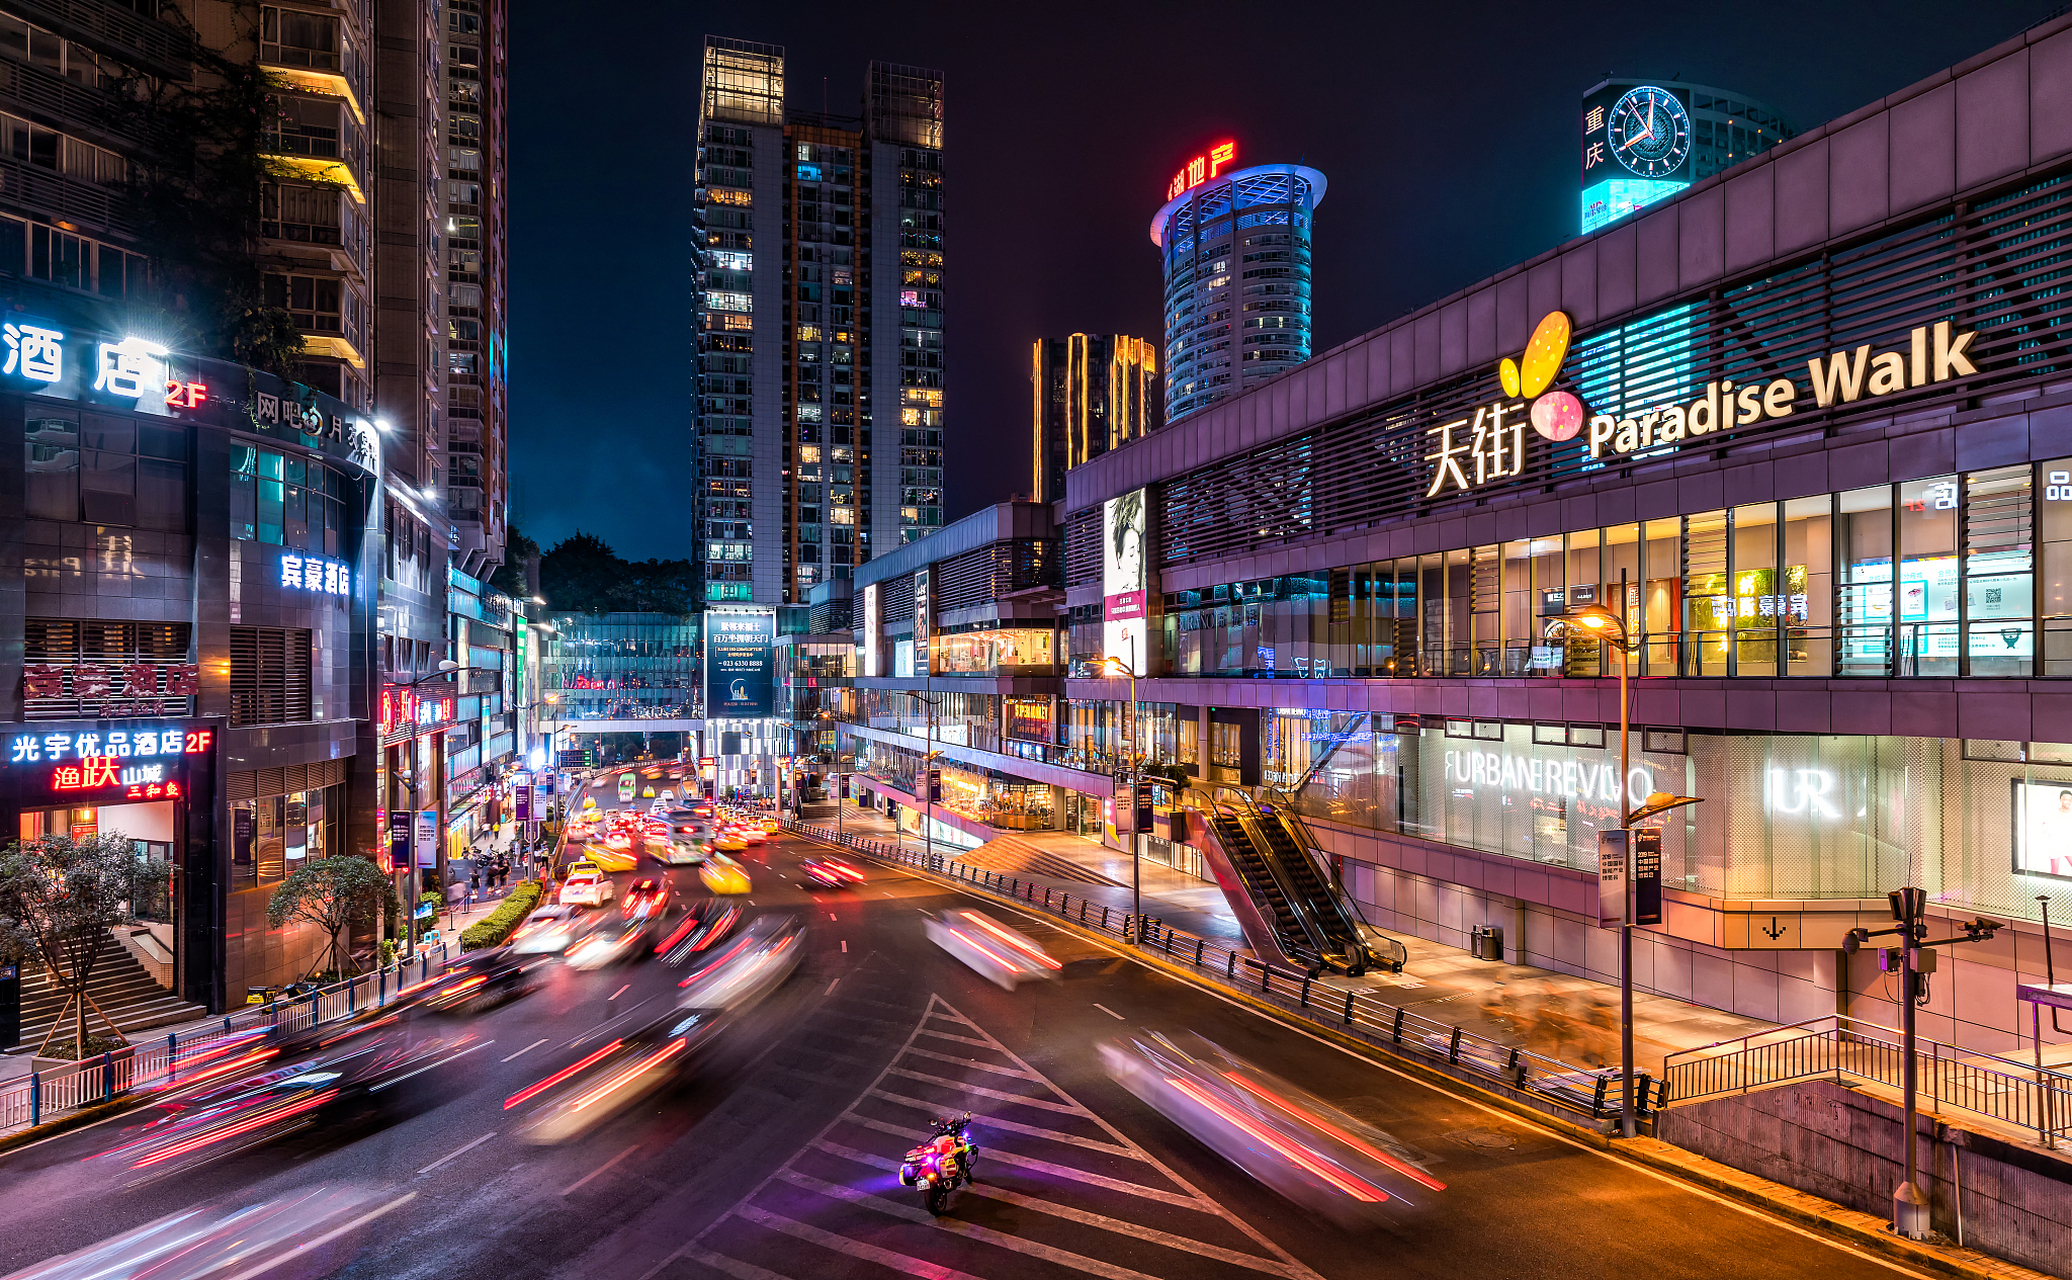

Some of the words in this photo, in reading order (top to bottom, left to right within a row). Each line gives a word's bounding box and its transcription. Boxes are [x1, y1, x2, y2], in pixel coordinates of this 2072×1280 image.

[1585, 105, 1605, 170] 重庆
[2, 323, 146, 398] 酒店
[164, 379, 208, 408] 2F
[257, 391, 303, 429] 网吧
[1426, 402, 1527, 497] 天街
[1589, 377, 1797, 458] Paradise
[1808, 320, 1981, 408] Walk
[281, 554, 349, 595] 宾豪酒店
[11, 730, 184, 762] 光宇优品酒店
[185, 731, 211, 753] 2F
[53, 755, 120, 790] 渔跃
[122, 764, 163, 785] 山城
[1455, 750, 1533, 791] URBAN
[1770, 766, 1840, 818] UR
